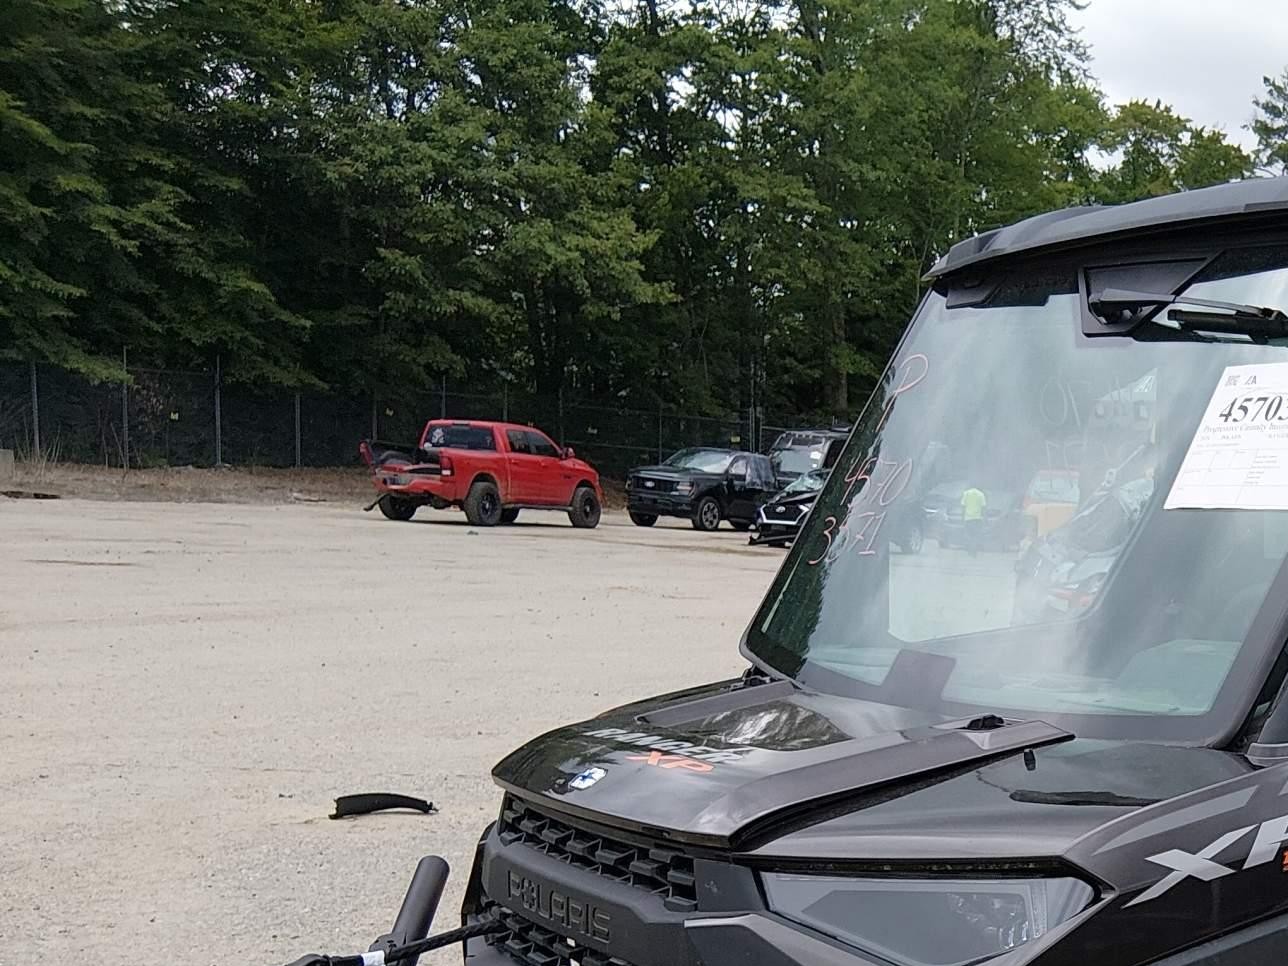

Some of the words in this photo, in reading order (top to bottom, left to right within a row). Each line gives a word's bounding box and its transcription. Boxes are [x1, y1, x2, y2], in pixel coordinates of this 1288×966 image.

[839, 452, 913, 507] 4570
[624, 751, 715, 772] XP
[507, 869, 611, 944] POLARIS
